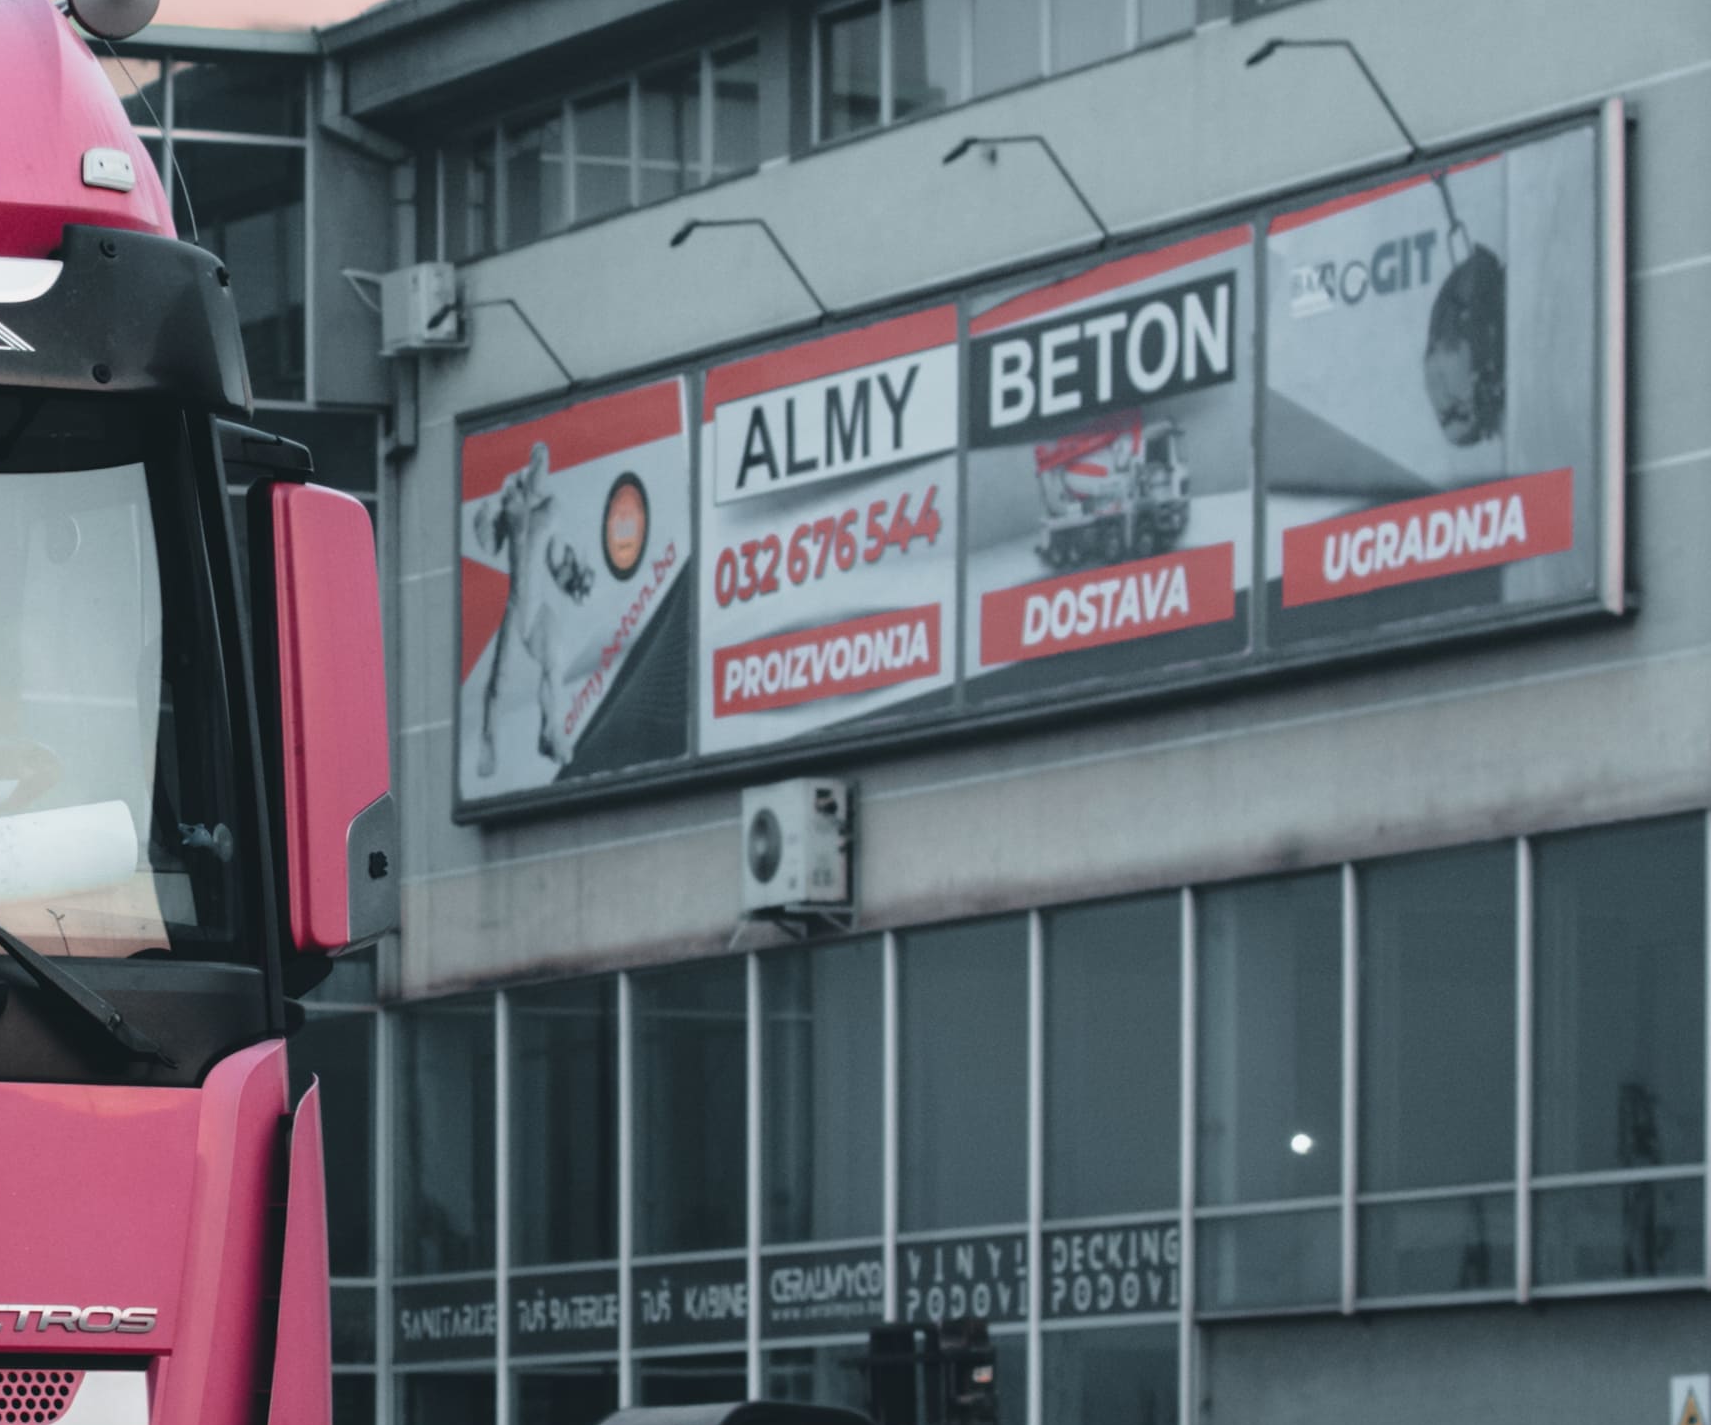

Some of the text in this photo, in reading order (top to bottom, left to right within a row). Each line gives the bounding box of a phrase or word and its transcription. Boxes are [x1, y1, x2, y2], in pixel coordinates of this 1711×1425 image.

[990, 284, 1230, 430] BETON
[735, 364, 920, 490] ALMY
[714, 484, 941, 608] 032 676 544
[1322, 494, 1527, 583] UGRADNJA
[1021, 565, 1189, 647] DOSTAVA
[722, 620, 929, 702] PROIZVODNJA
[1051, 1227, 1179, 1274] DECKING
[1051, 1271, 1178, 1313] PODOVI
